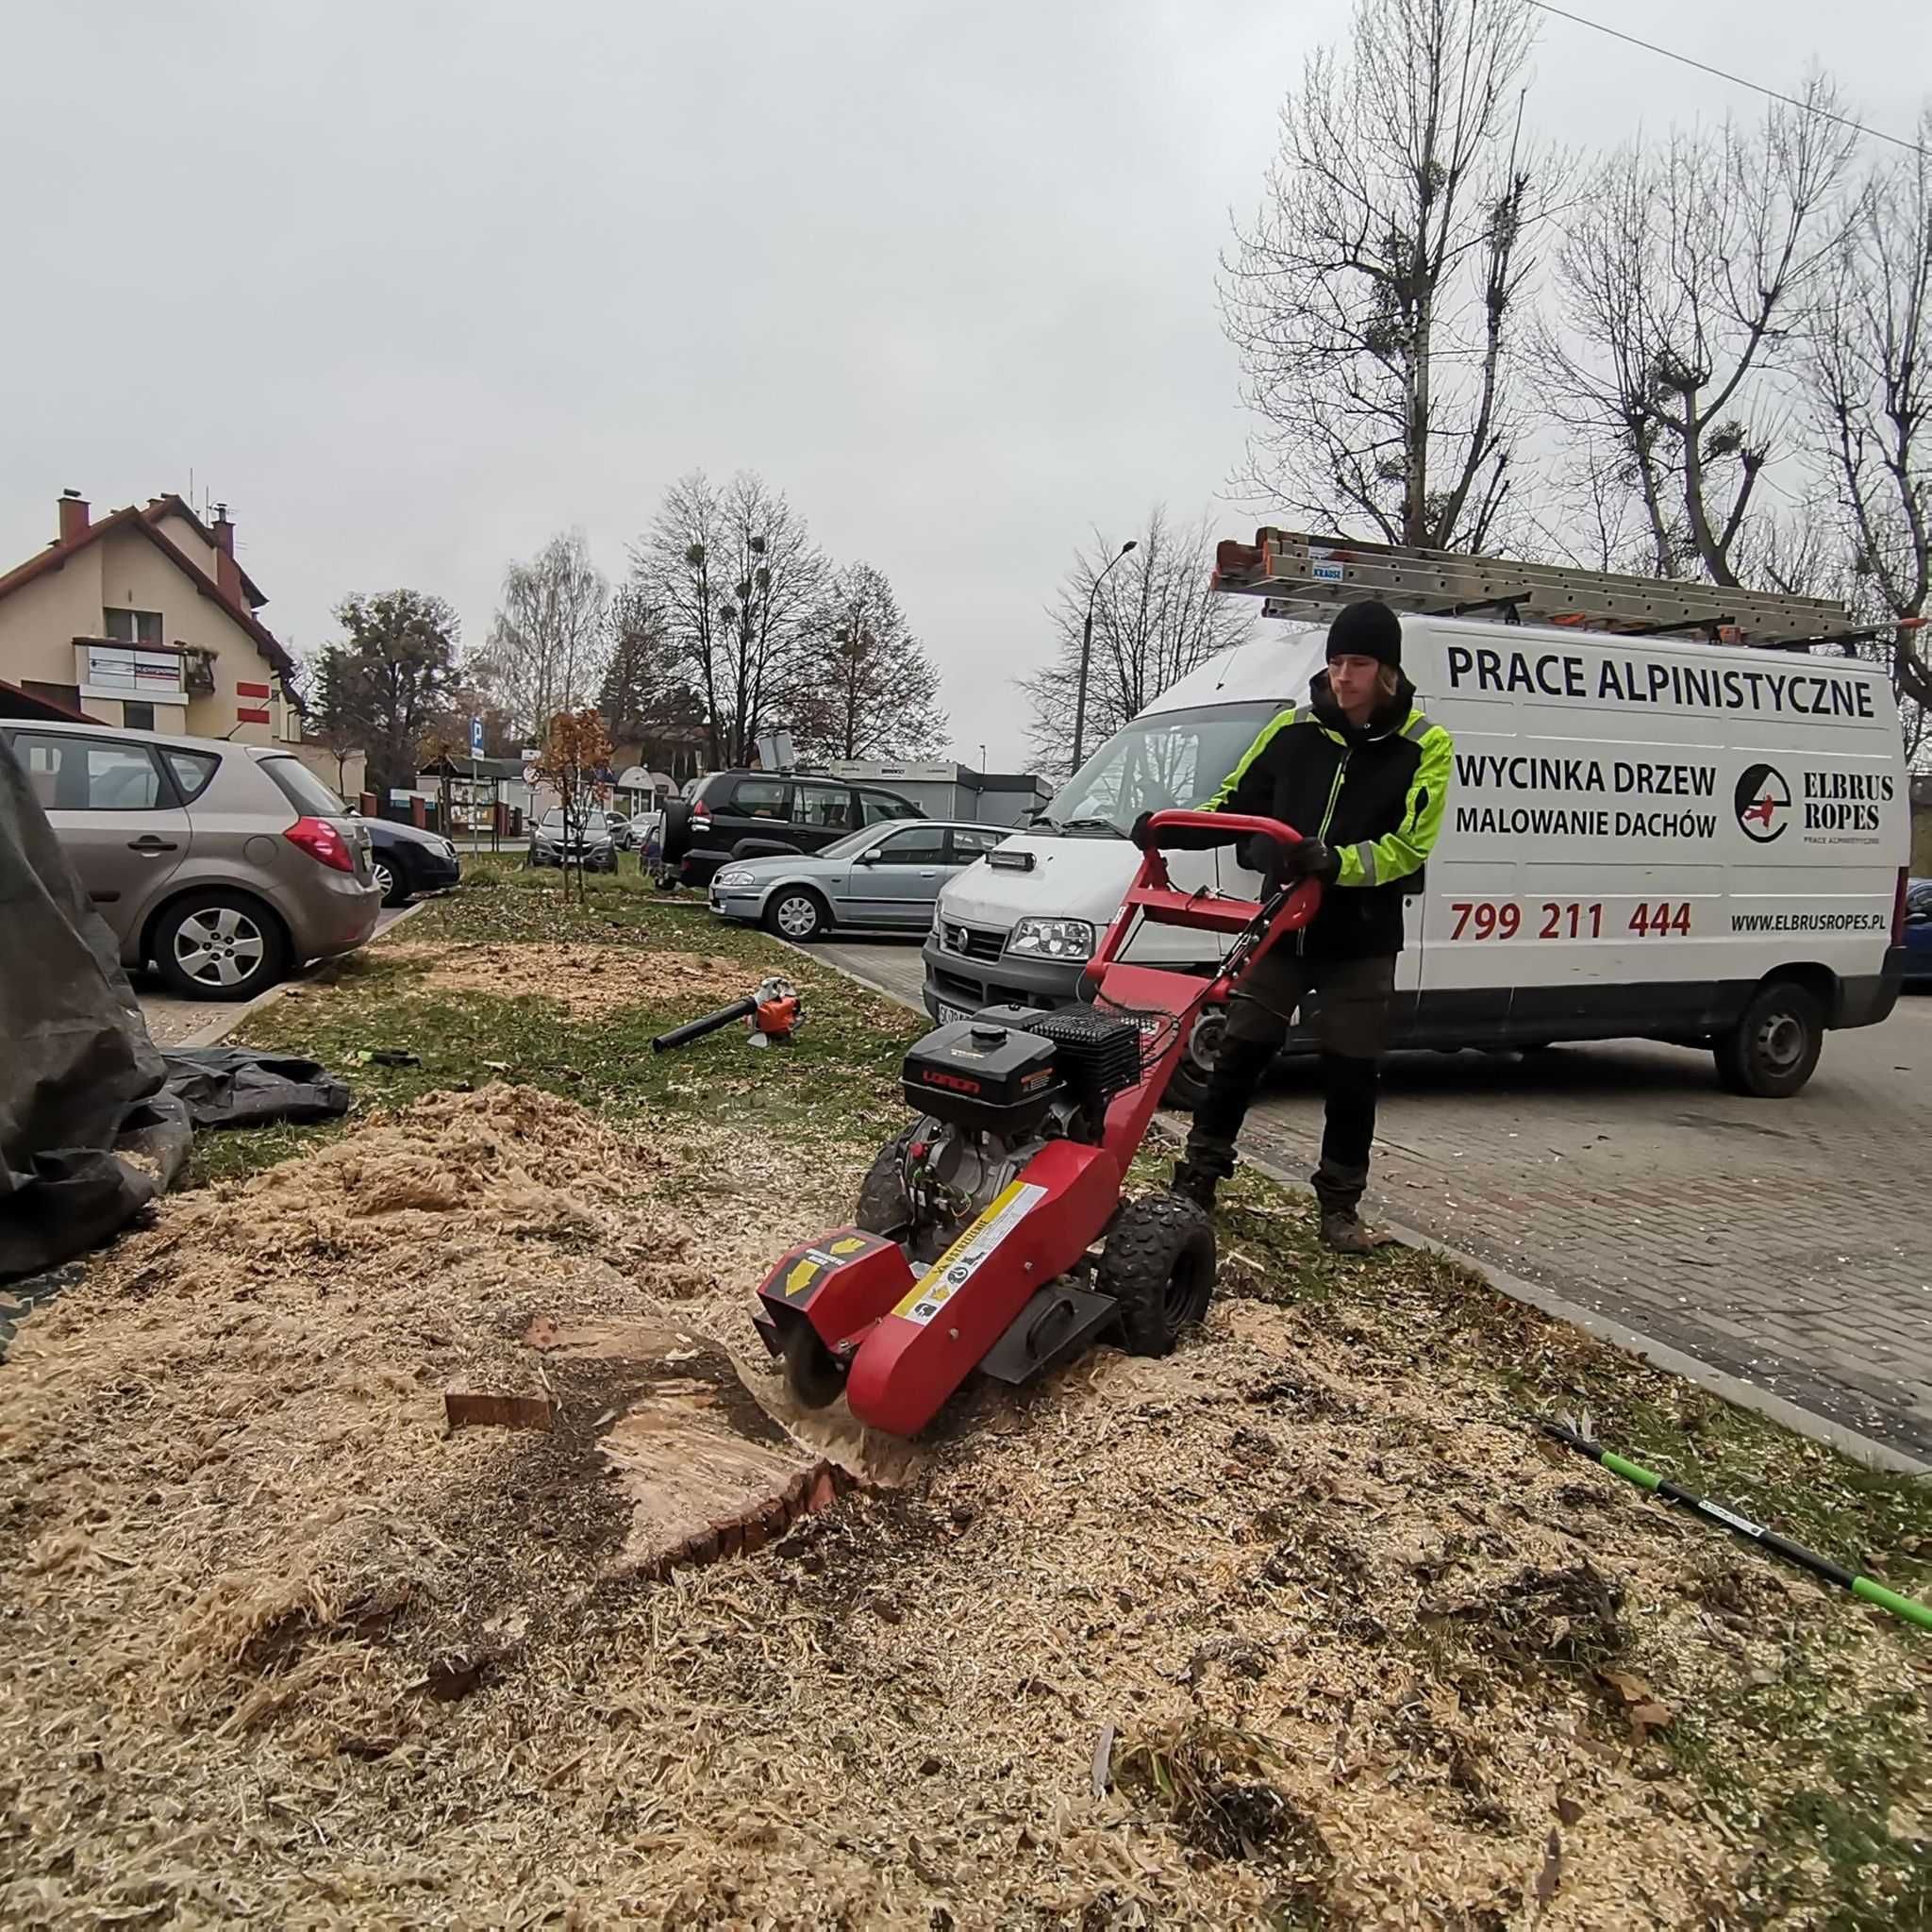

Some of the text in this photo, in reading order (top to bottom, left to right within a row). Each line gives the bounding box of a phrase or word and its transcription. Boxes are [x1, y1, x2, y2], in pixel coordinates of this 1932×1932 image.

[1448, 646, 1874, 718] PRACE ALPINISTYCZNE
[474, 723, 482, 745] P
[1456, 754, 1717, 796] WYCINKA DRZEW
[1804, 772, 1893, 801] ELBRUS
[1456, 807, 1717, 839] MALOWANIE DACHÓW
[1804, 803, 1879, 830] ROPES
[1451, 902, 1691, 941] 799 211 444
[1731, 913, 1886, 932] WWW.ELBRUSROPES.PL
